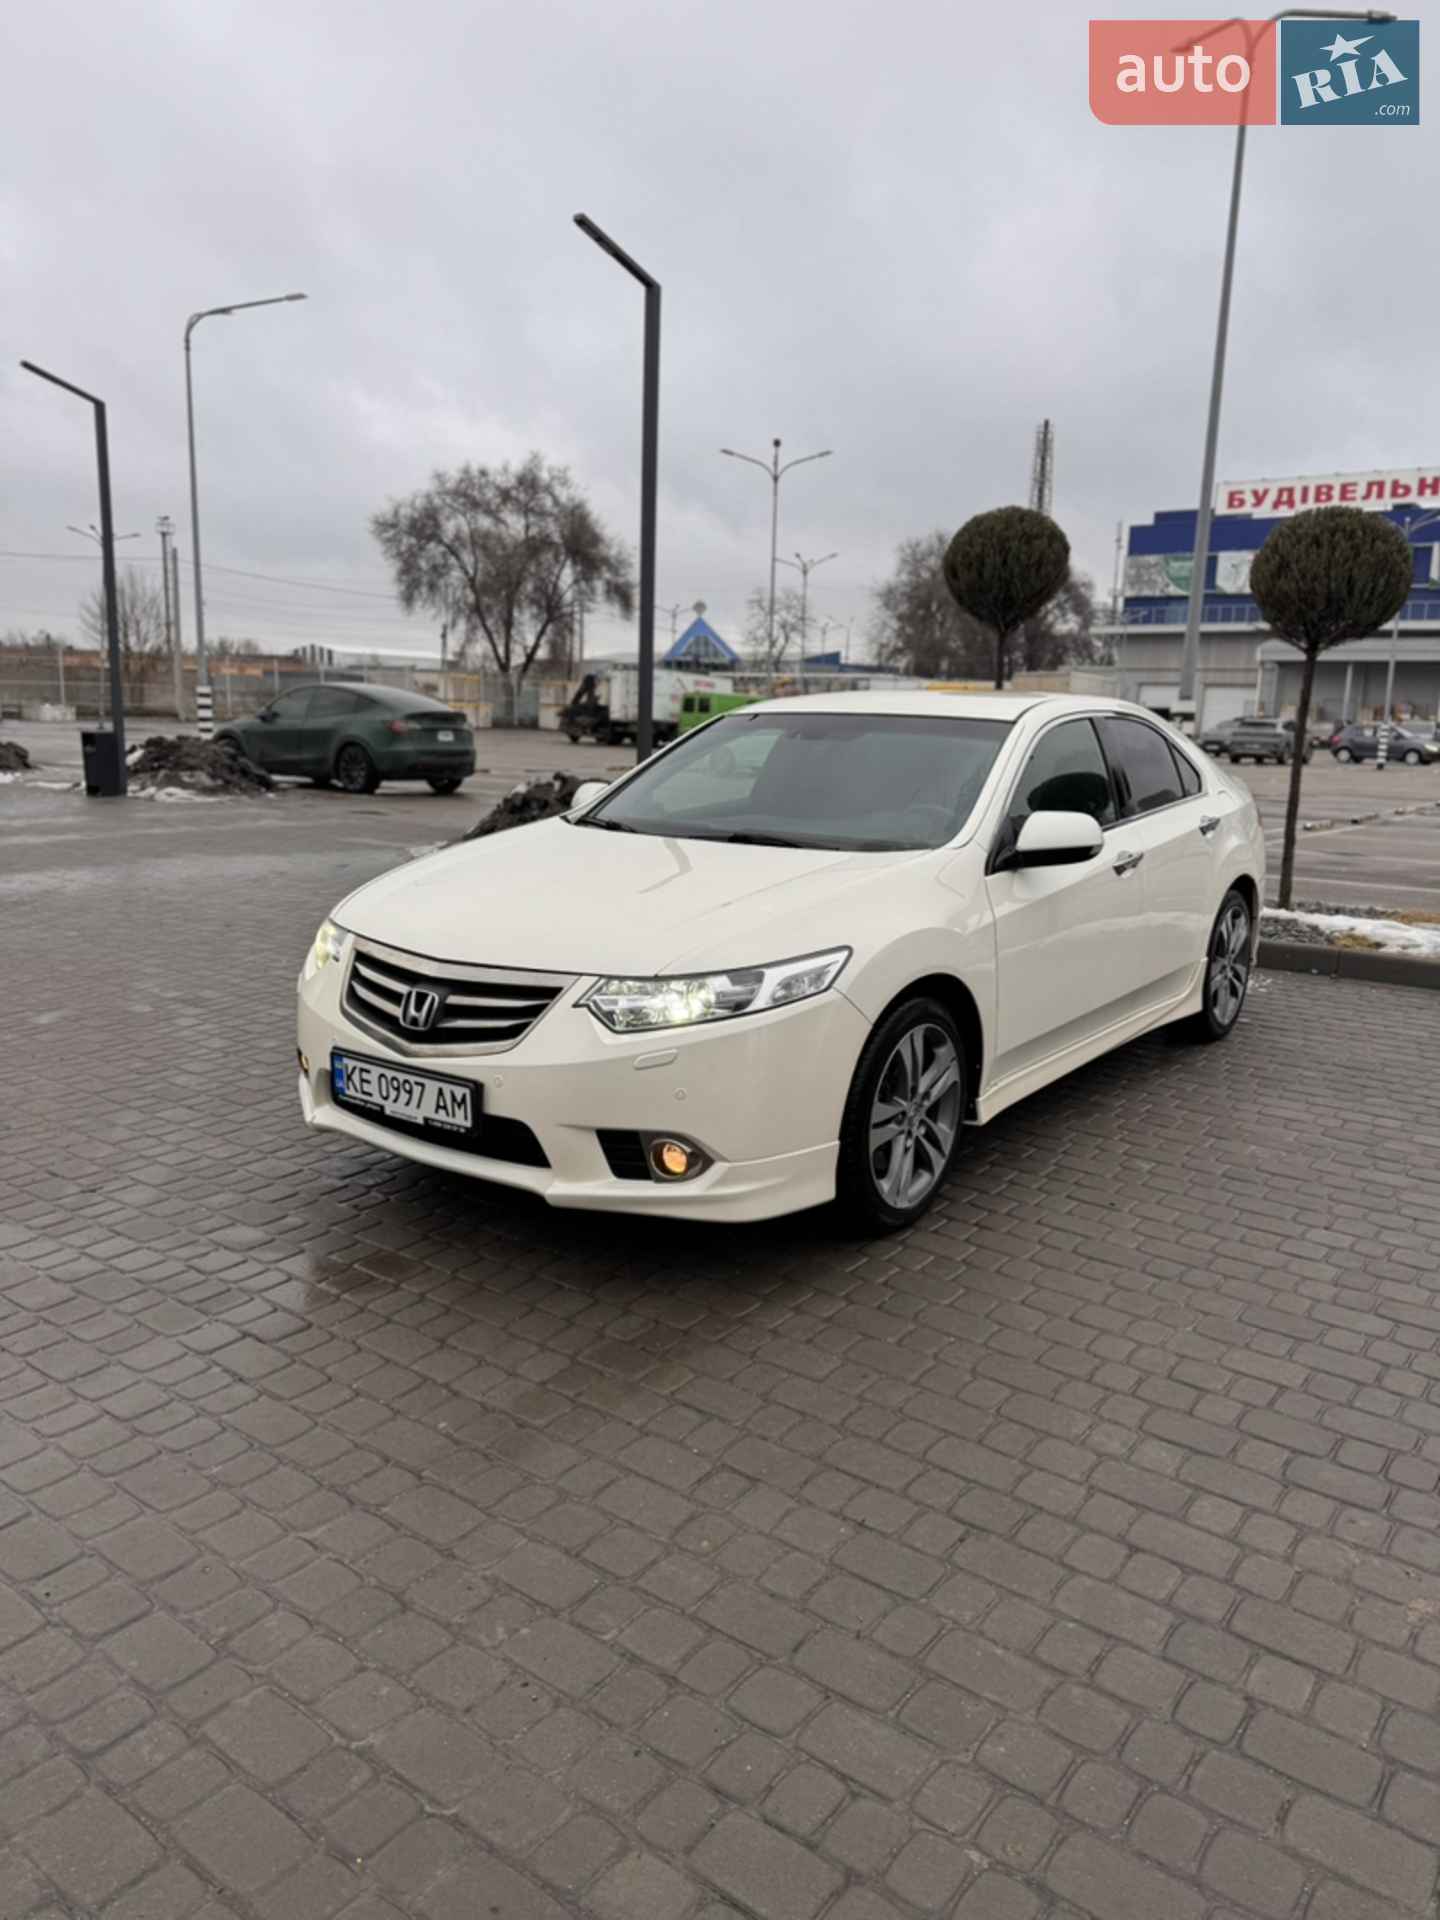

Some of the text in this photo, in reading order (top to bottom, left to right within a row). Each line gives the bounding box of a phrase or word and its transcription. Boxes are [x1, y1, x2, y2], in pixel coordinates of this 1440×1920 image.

[1228, 476, 1440, 509] БУДІВЕЛЬН
[344, 1063, 373, 1097] KE
[378, 1073, 426, 1109] 0997
[434, 1086, 468, 1121] AM
